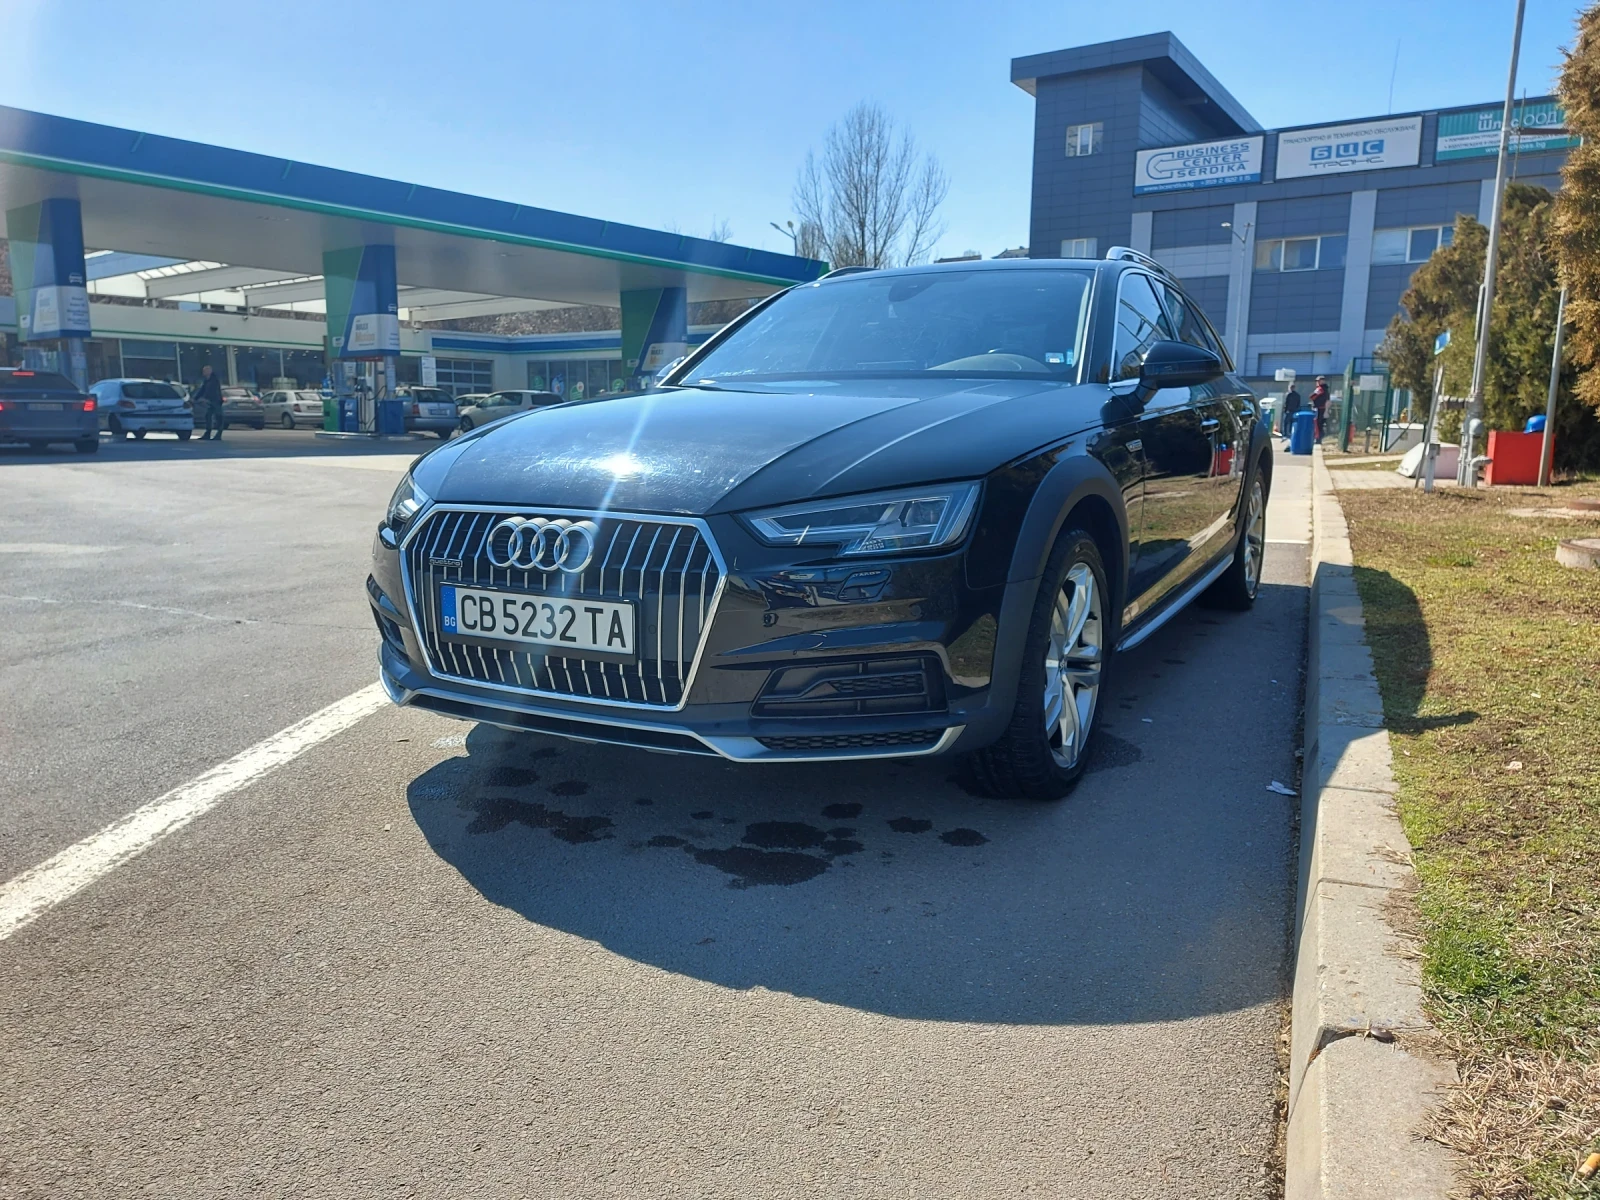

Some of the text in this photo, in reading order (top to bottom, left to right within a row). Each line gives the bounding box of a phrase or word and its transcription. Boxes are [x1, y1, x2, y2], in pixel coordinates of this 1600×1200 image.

[1523, 111, 1557, 126] ООД
[1177, 142, 1249, 158] BUSINESS
[1182, 153, 1242, 168] CENTER
[1177, 163, 1246, 178] SERDIKA
[444, 615, 456, 626] BG
